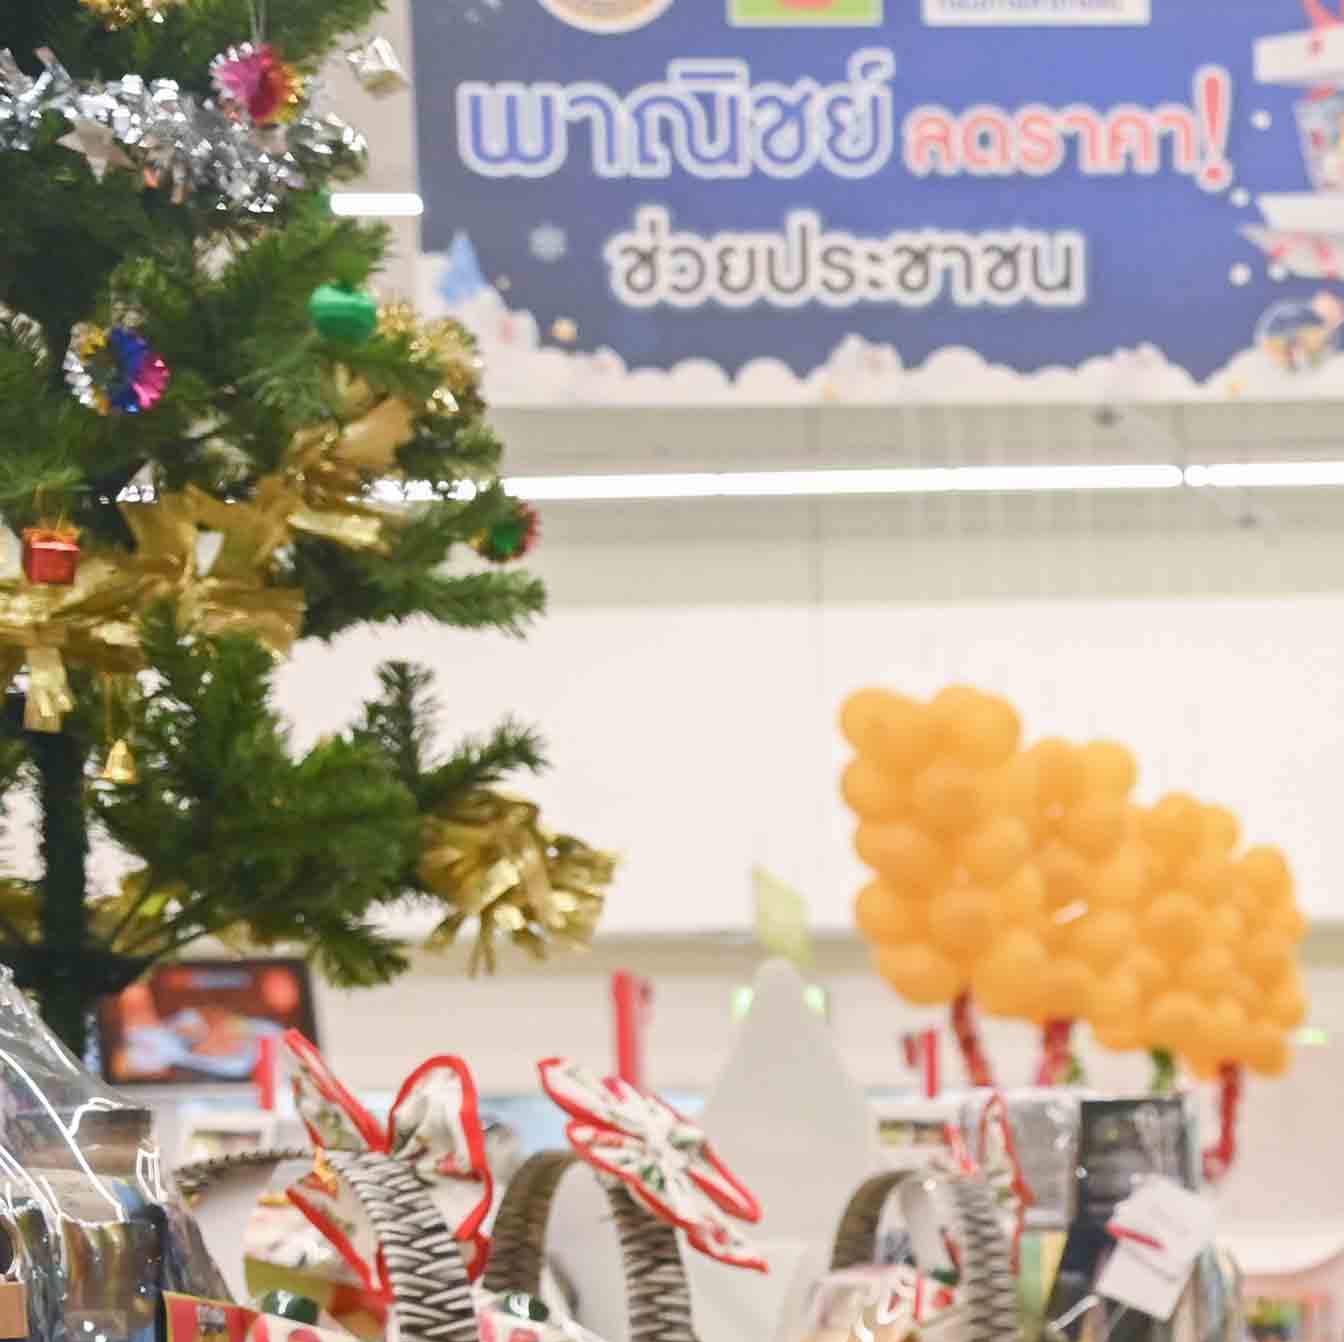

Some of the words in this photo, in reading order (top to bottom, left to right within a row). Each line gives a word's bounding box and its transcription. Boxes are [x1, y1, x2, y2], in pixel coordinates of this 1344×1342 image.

[458, 49, 894, 178] พาณิชย์
[904, 66, 1232, 190] ลดราคา!
[606, 204, 1087, 307] ช่วยประชาชน
